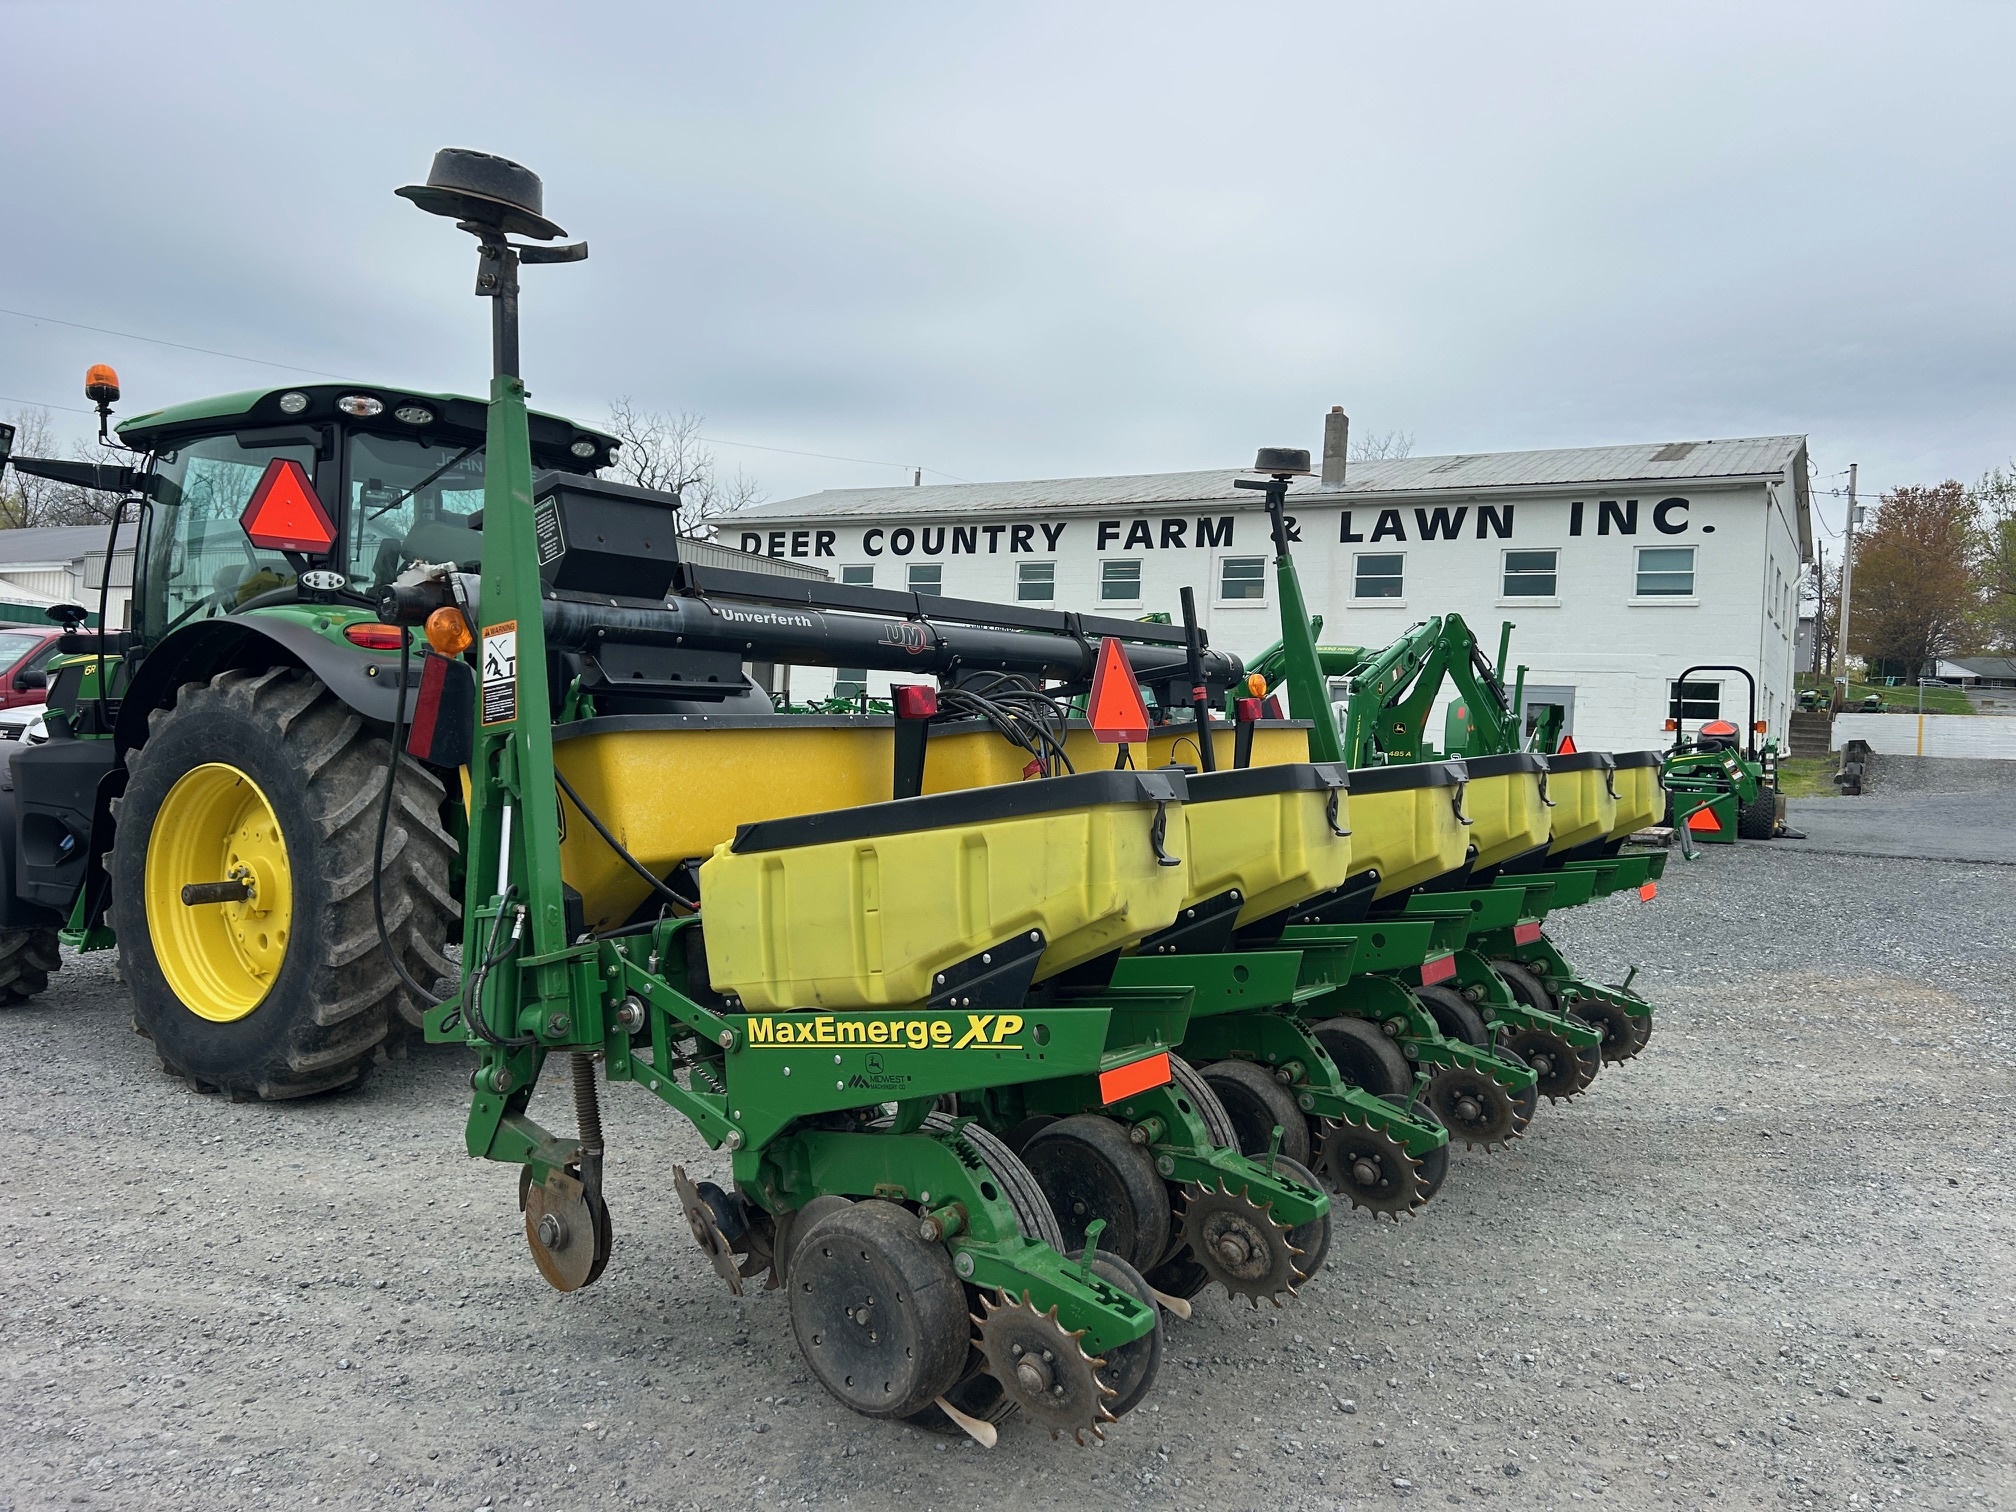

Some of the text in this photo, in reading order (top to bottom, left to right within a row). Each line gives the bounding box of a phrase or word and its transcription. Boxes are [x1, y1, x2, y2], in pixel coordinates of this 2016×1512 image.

[740, 497, 1716, 557] DEER COUNTRY FARM & LAWN INC.
[721, 608, 812, 628] Unverferth
[490, 622, 515, 635] WARNING
[84, 664, 97, 676] 6R
[747, 1014, 1023, 1049] MaxEmerge XP
[870, 1075, 905, 1084] MIDWEST
